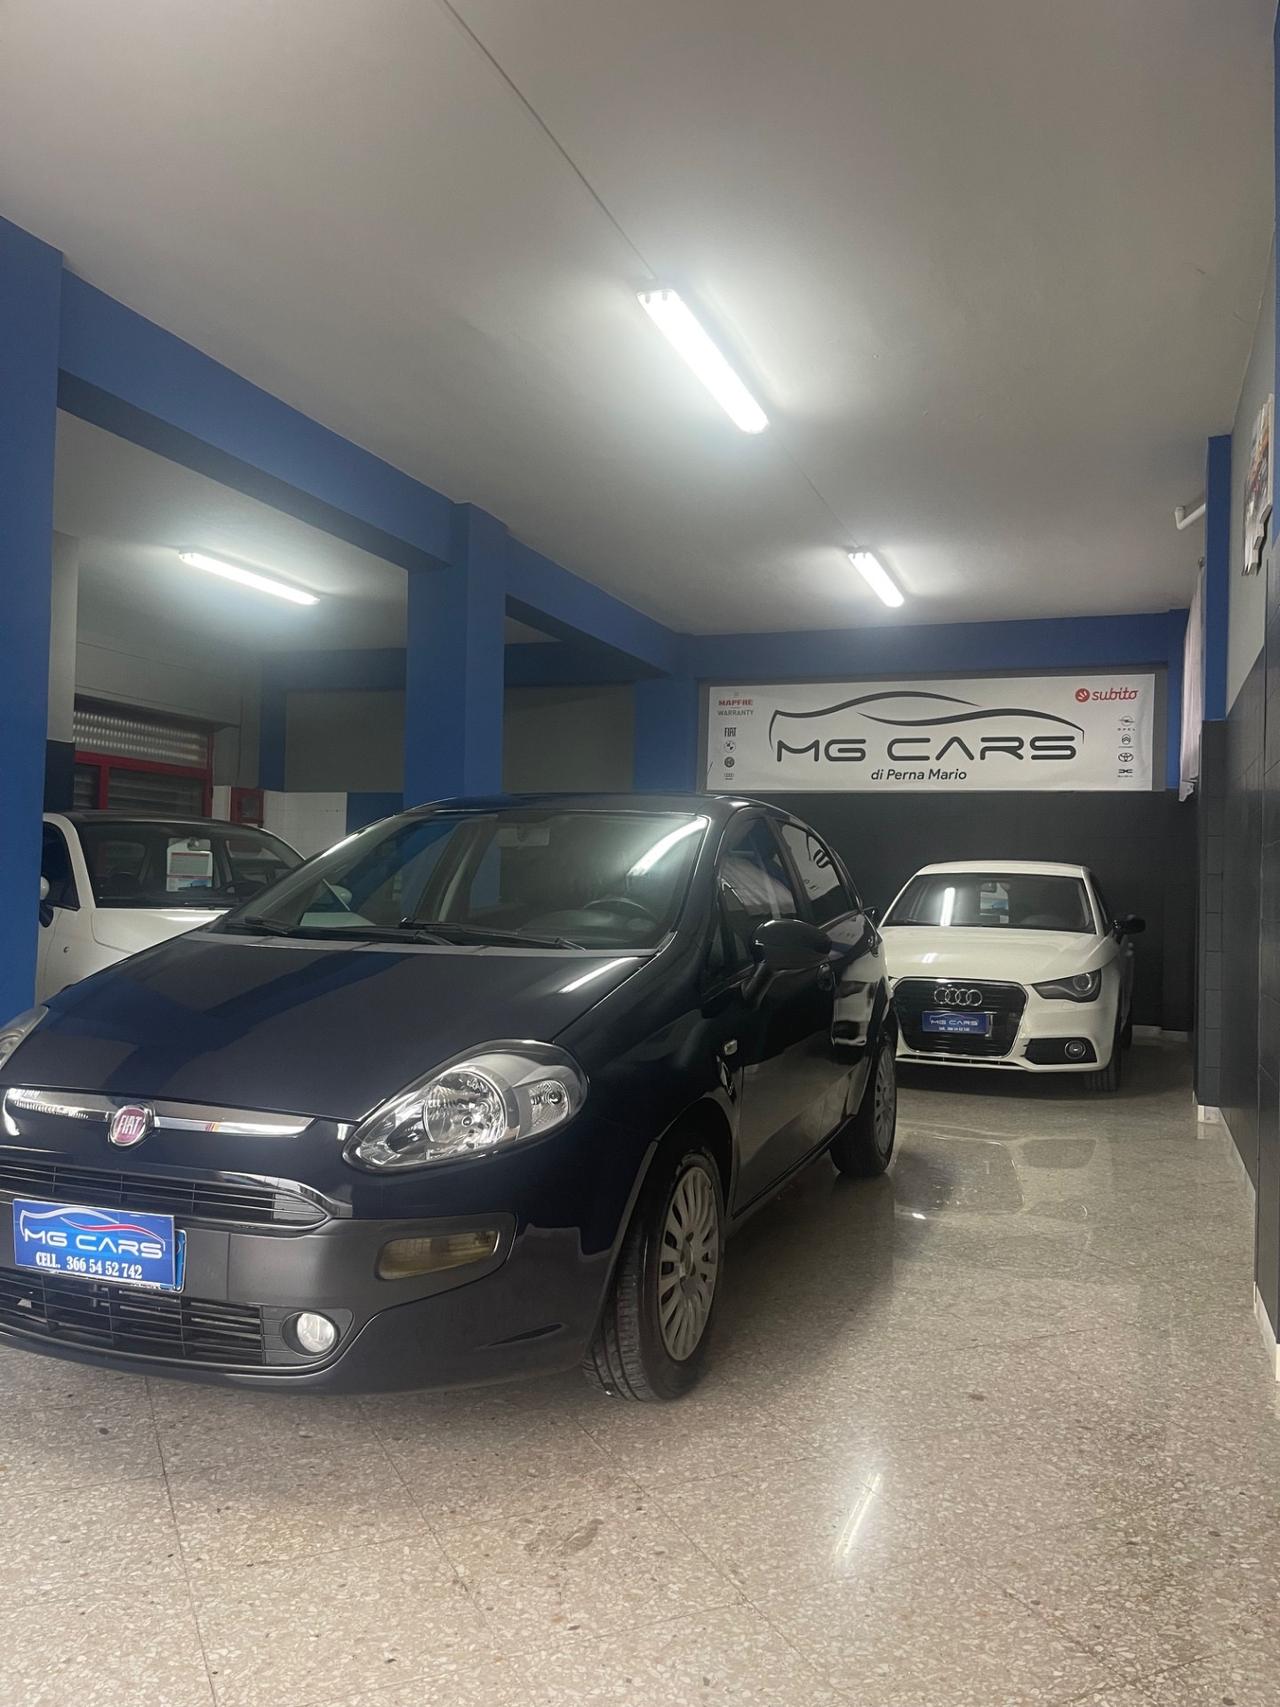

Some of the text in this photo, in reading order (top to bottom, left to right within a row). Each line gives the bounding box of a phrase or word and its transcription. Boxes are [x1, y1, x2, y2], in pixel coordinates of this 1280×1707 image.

[718, 698, 754, 707] MAPFRE
[1091, 687, 1139, 701] subito
[724, 727, 737, 737] FIAT
[776, 735, 1077, 762] MG CARS
[870, 768, 967, 780] di Perna Mario
[117, 1114, 144, 1135] FIAT
[24, 1228, 163, 1259] MG CARS
[35, 1251, 143, 1280] CELL. 366 54 52 742
